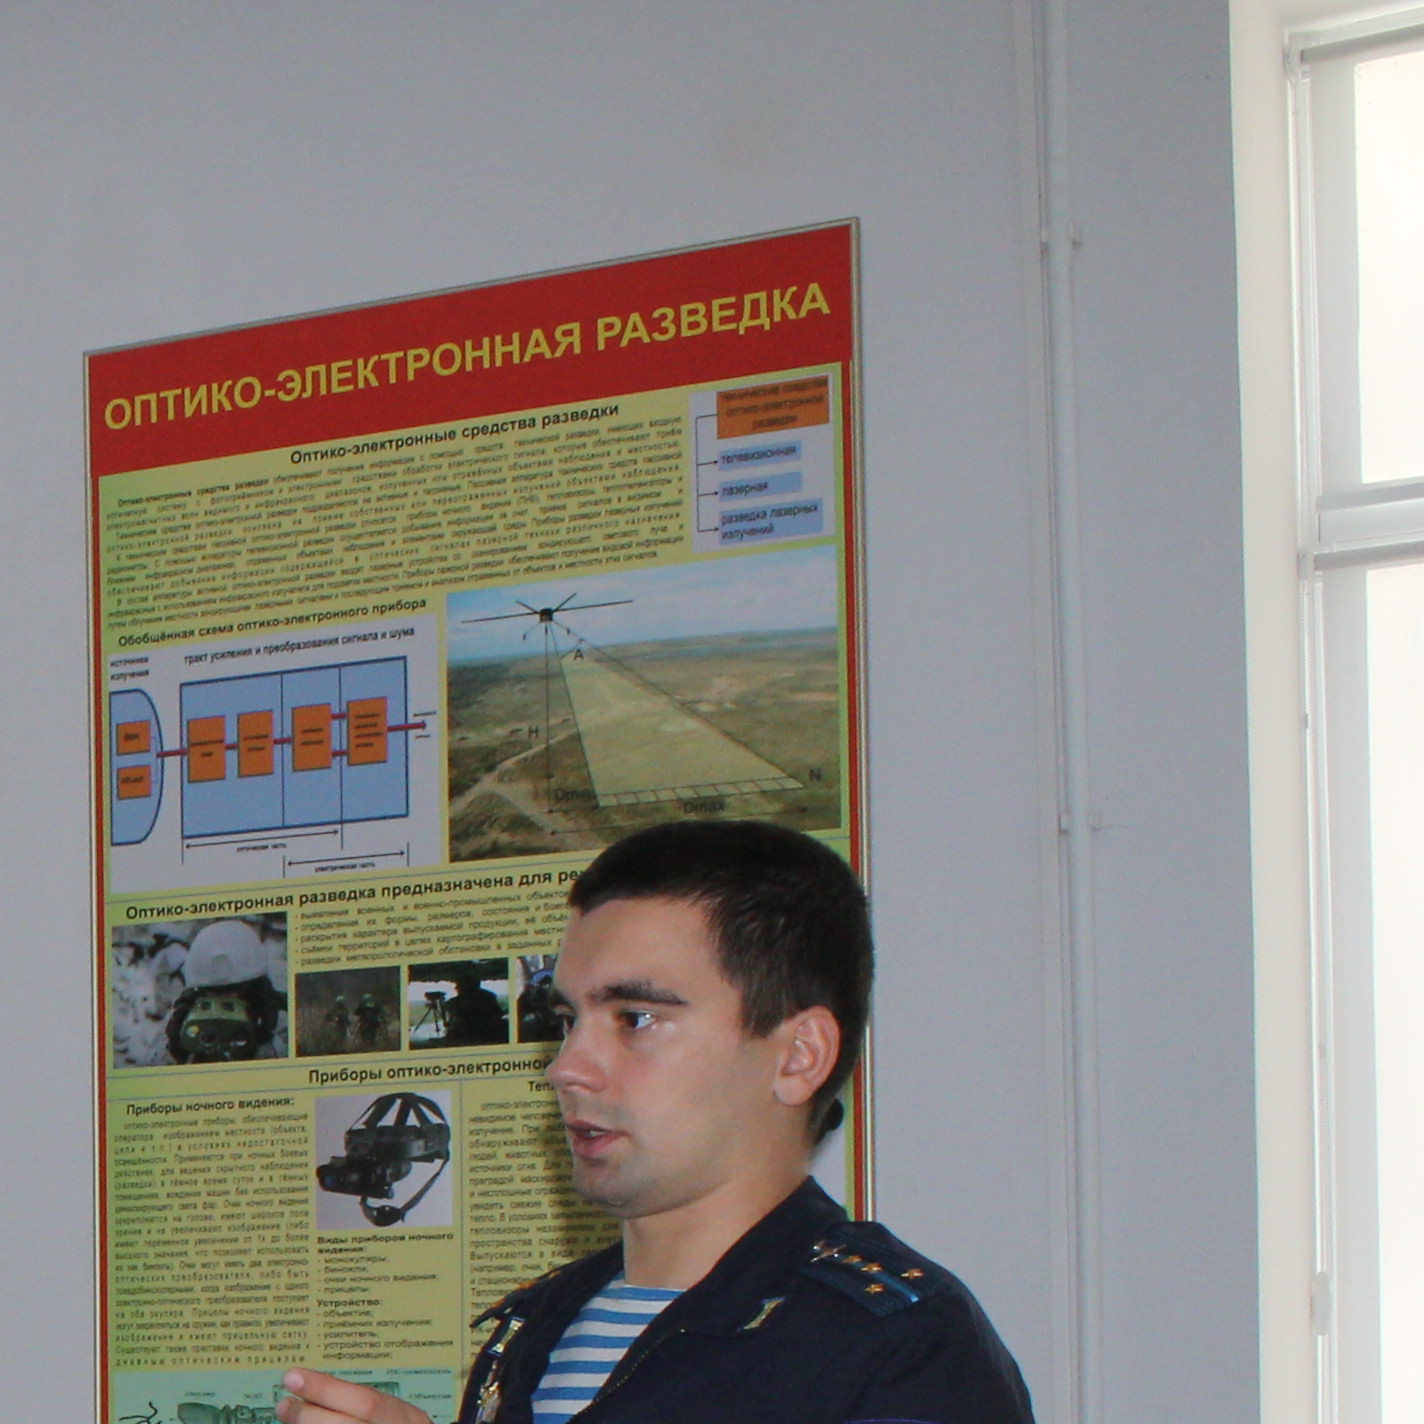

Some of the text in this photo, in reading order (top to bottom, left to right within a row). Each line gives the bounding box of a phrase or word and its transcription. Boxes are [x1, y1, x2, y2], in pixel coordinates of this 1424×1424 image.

[104, 280, 831, 432] ОПТИКО-ЭЛЕКТРОННАЯ РАЗВЕДКА
[290, 403, 618, 465] Оптико-электронные средства разведки
[722, 481, 767, 497] лазерная
[118, 597, 425, 647] Обобщённая схема оптико-электронного прибора
[125, 892, 294, 921] Оптико-электронная
[299, 887, 375, 907] разведка
[382, 875, 512, 900] предназначена
[518, 871, 551, 888] для
[308, 1066, 381, 1083] Приборы
[126, 1096, 294, 1116] Приборы ночного видения:
[317, 1232, 453, 1244] Виды приборов ночного
